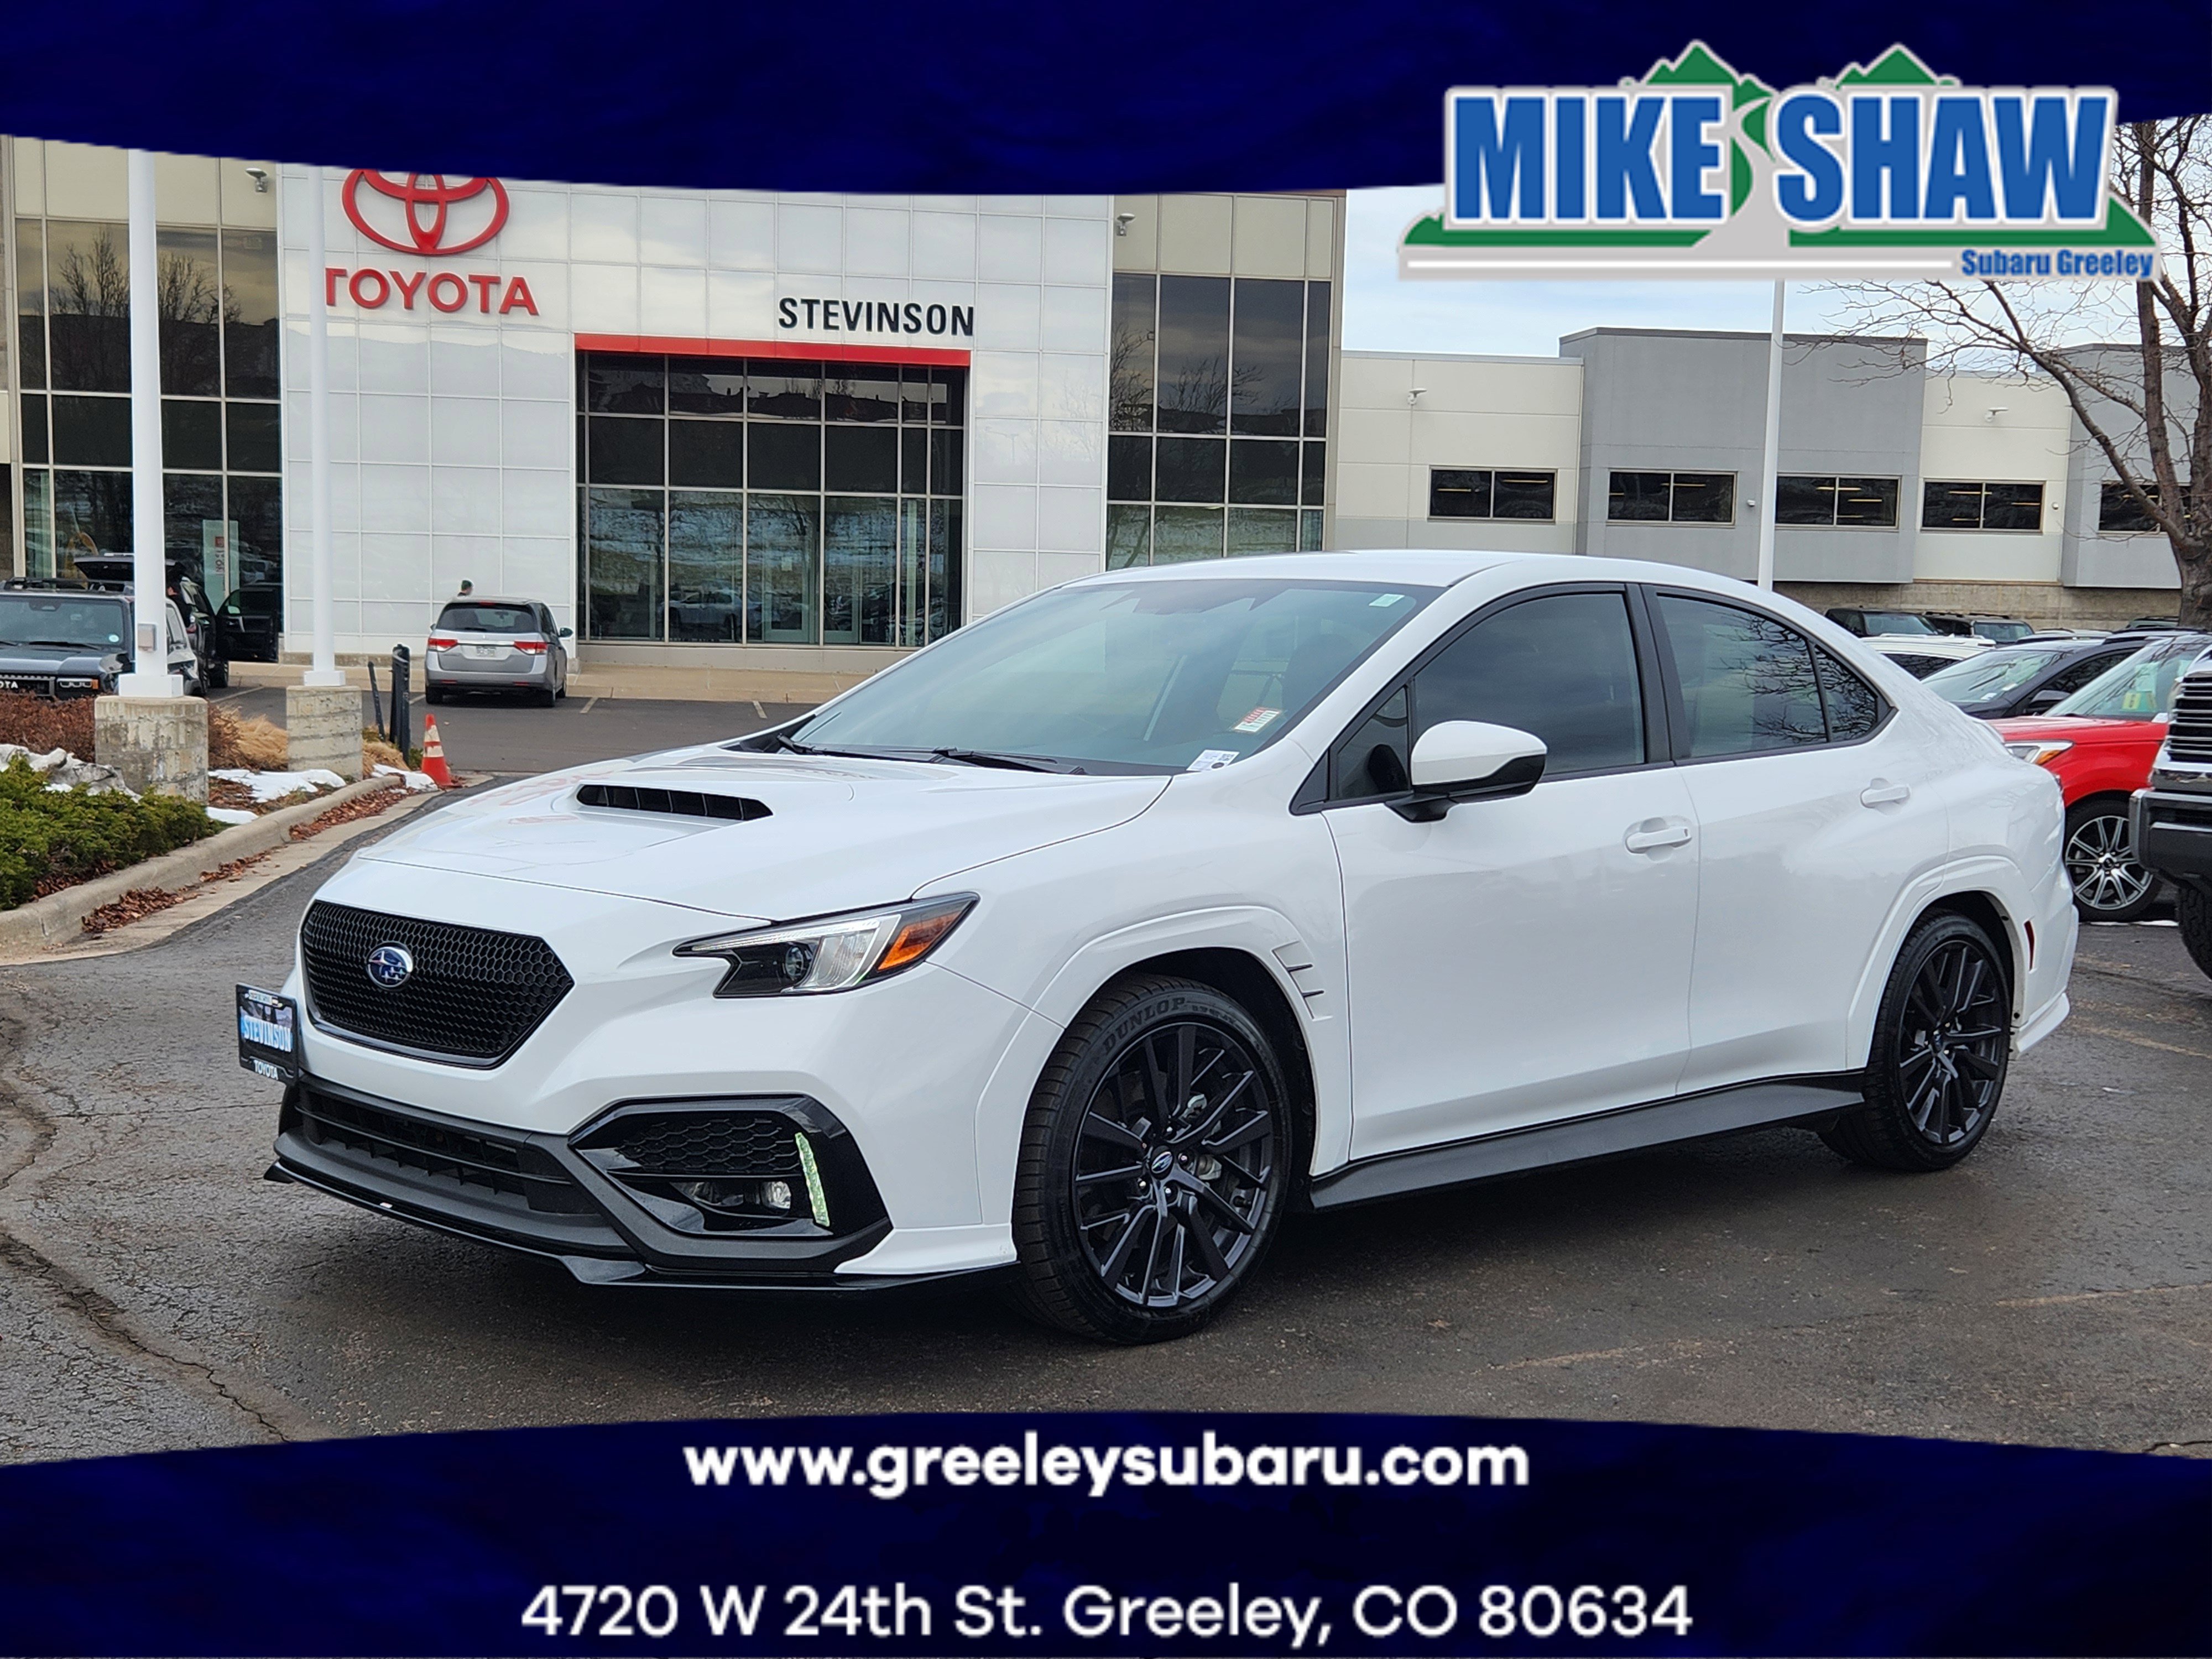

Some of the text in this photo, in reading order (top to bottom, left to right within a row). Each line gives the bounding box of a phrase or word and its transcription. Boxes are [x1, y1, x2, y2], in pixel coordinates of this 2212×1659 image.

[326, 268, 538, 315] TOYOTA
[778, 297, 975, 337] STEVINSON
[244, 1015, 291, 1052] STEVINSON
[1102, 997, 1186, 1051] DUNLOP
[254, 1059, 278, 1080] TOYOTA
